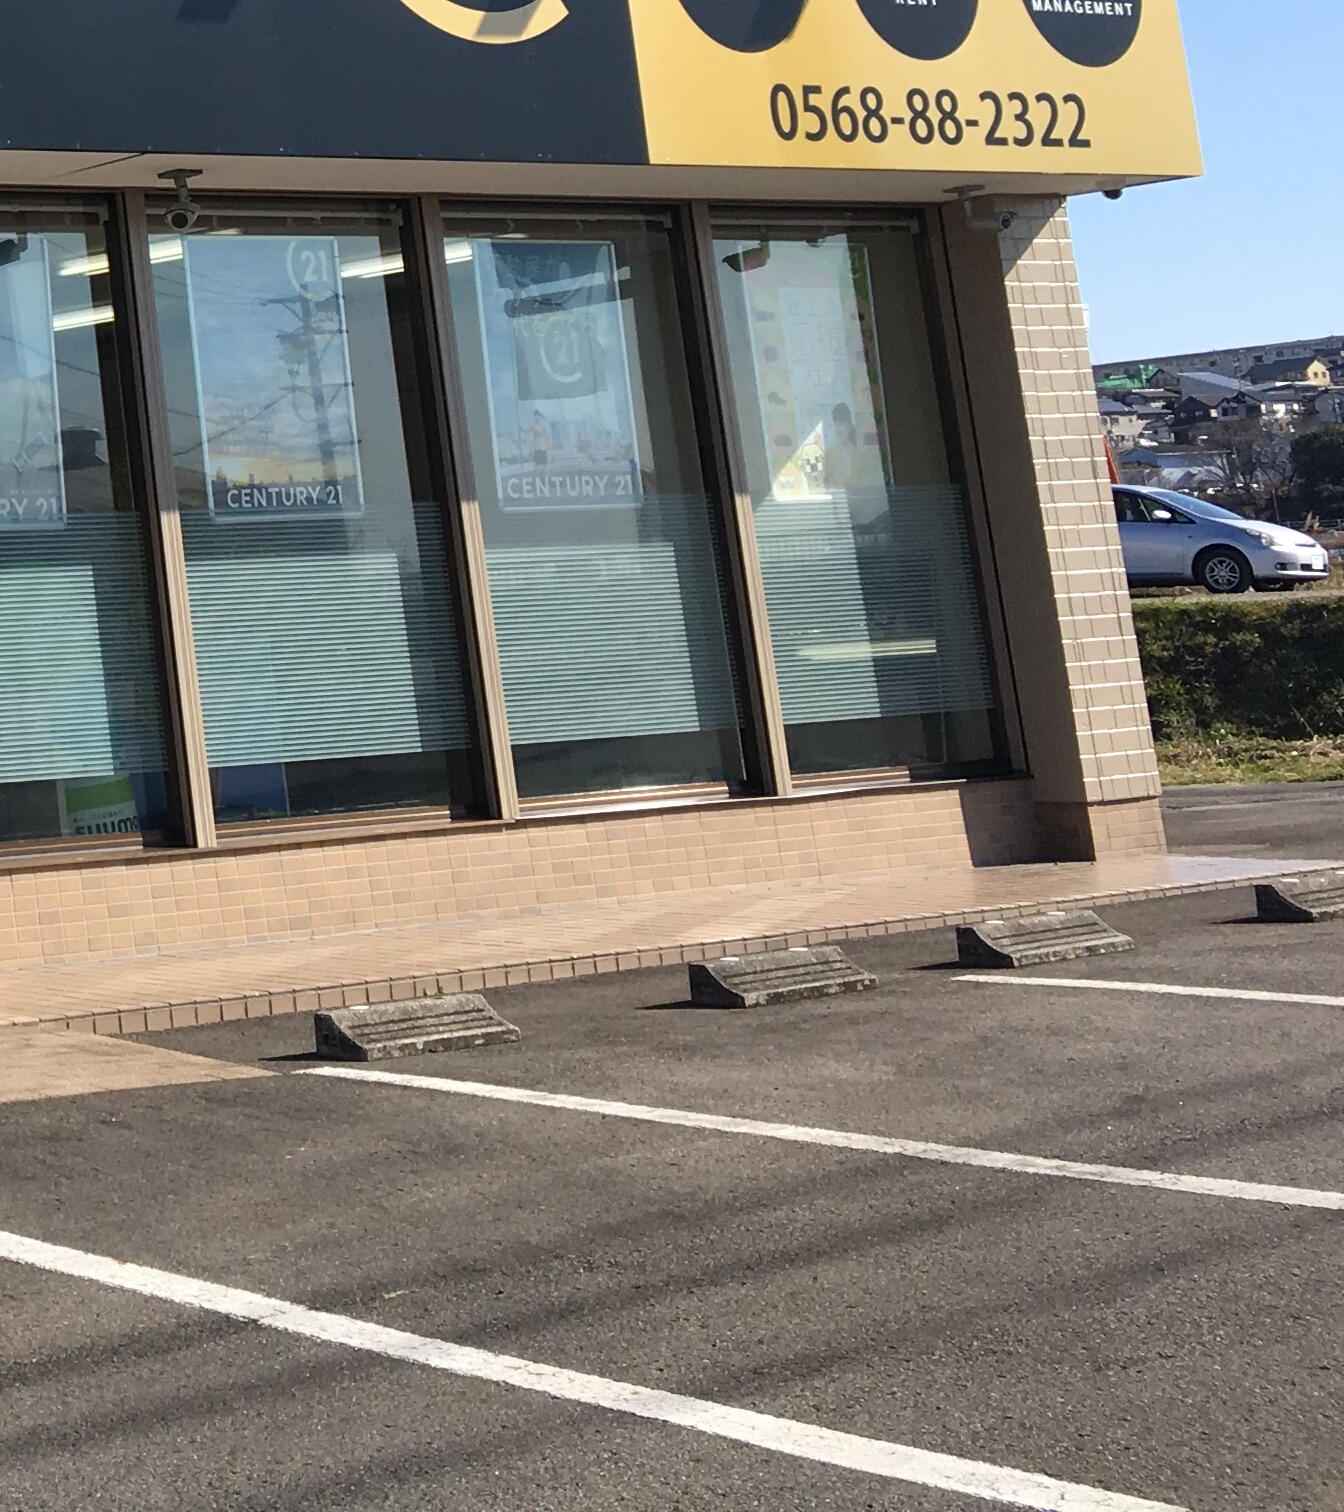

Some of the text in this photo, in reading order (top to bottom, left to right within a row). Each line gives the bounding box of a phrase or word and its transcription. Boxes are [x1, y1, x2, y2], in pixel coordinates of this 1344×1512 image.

[770, 83, 1092, 149] 0568-88-2322
[227, 485, 343, 508] CENTURY 21
[507, 475, 633, 498] CENTURY 21
[35, 497, 59, 522] 21
